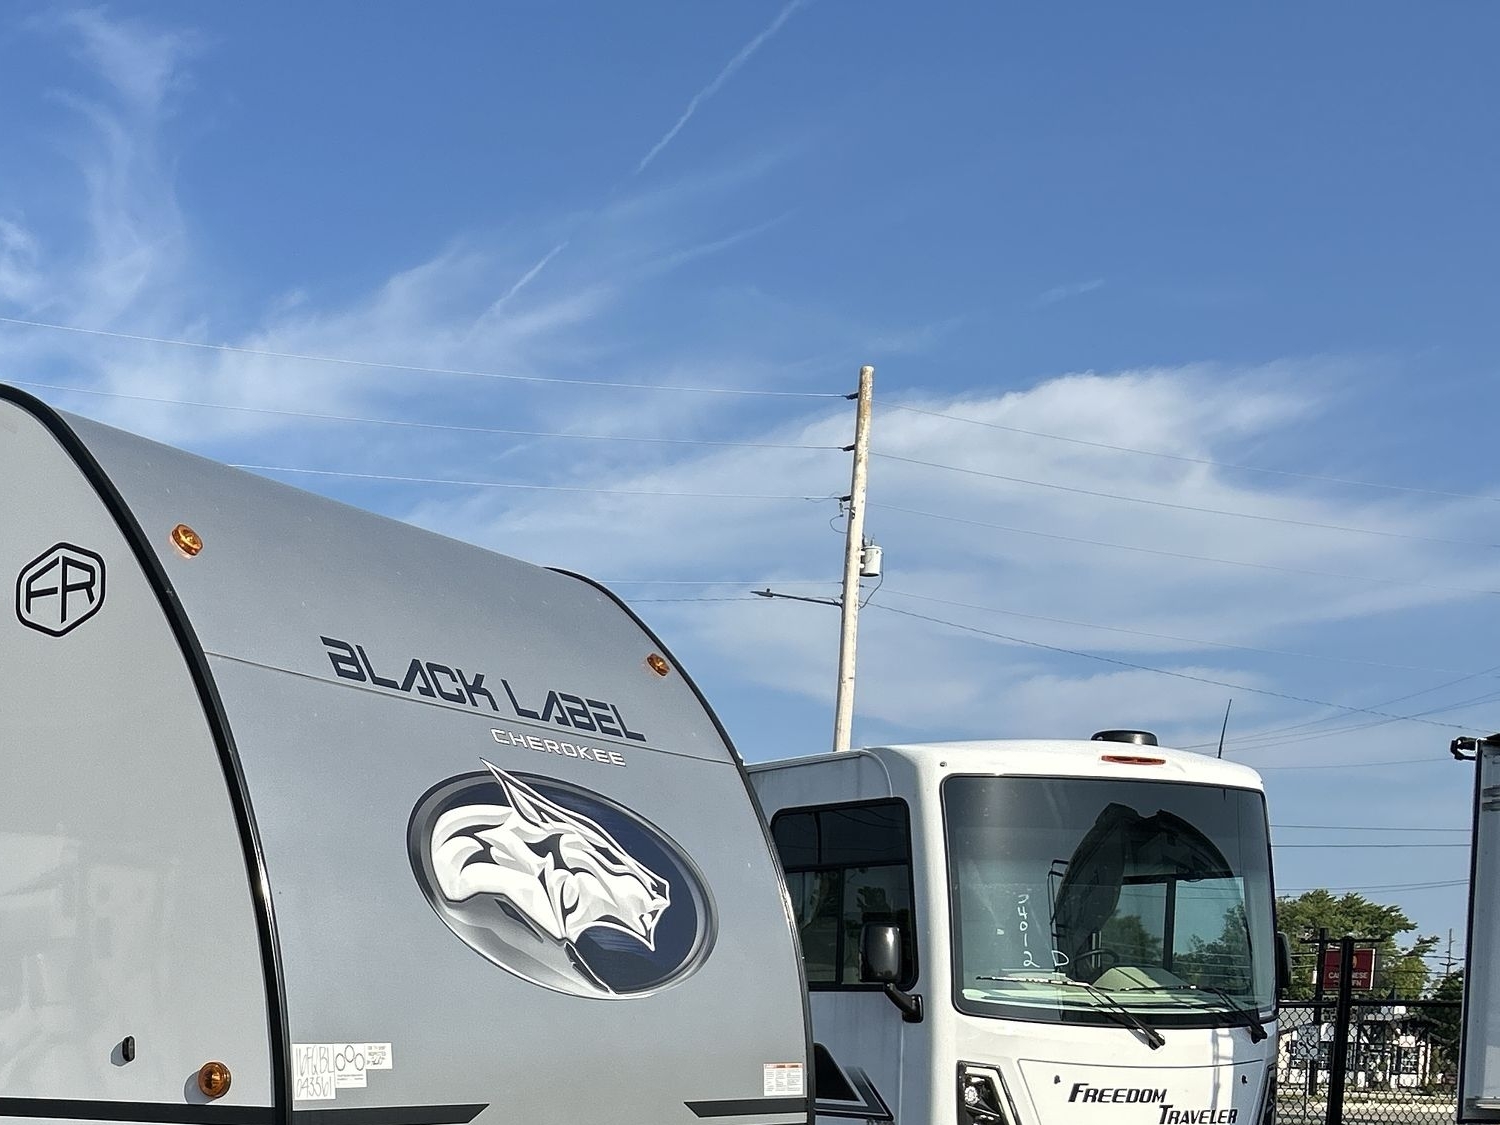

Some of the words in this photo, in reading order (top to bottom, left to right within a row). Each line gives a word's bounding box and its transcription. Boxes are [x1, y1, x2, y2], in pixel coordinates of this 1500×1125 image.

[320, 635, 499, 712] BLACK
[500, 678, 647, 742] LABEL
[490, 728, 627, 767] CHEROKEE
[1068, 1083, 1167, 1104] FREEDOM
[1159, 1104, 1238, 1125] TRAVELER
